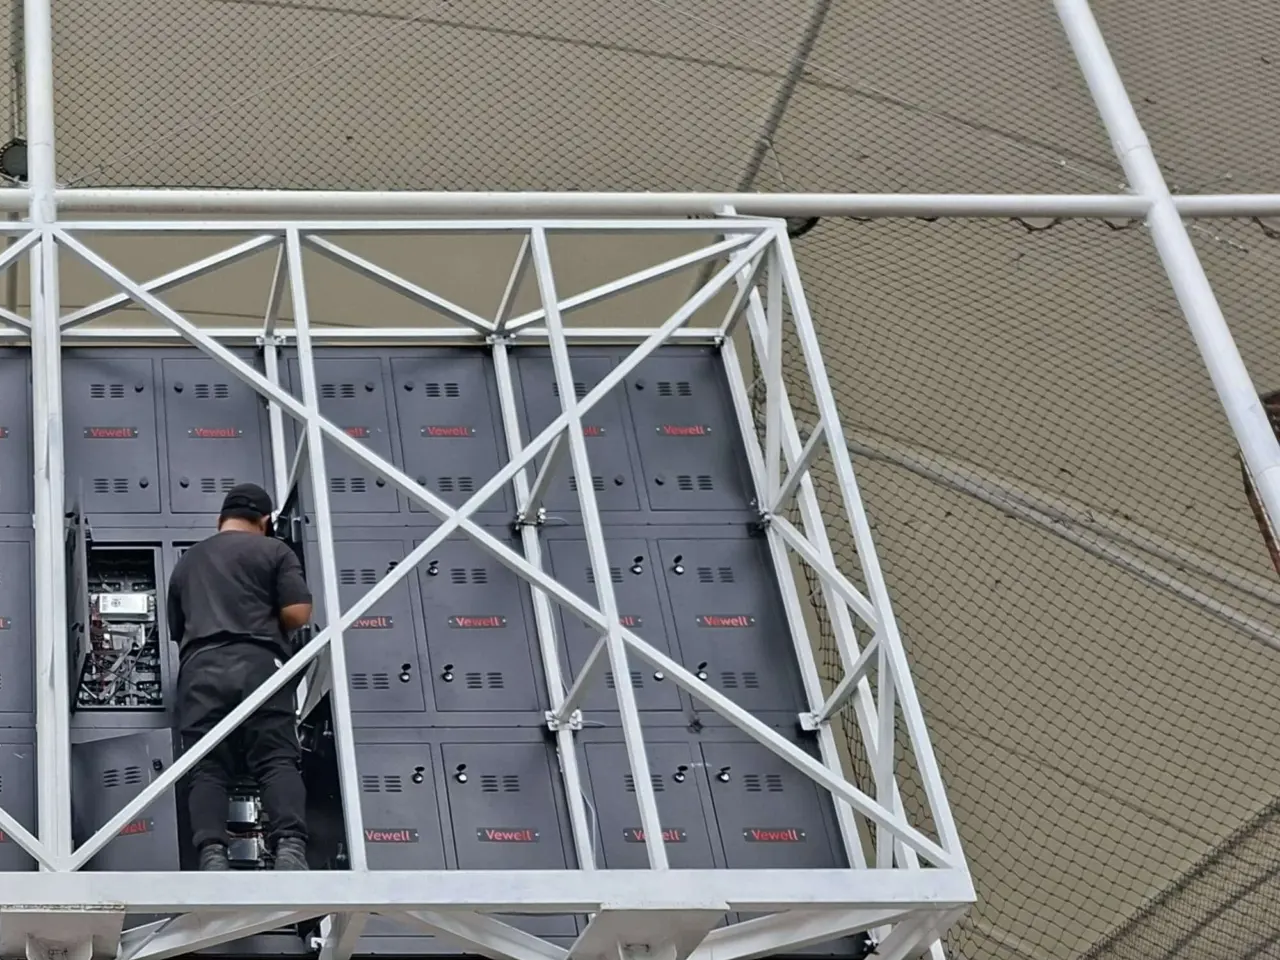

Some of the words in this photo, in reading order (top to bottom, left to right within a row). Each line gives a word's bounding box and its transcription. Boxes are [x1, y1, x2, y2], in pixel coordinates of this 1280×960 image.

[91, 427, 132, 437] Vewell
[195, 427, 236, 437] Vewell
[427, 426, 468, 436] Vewell
[663, 425, 704, 435] Vewell
[455, 617, 500, 627] Vewell
[703, 616, 748, 627] Vewell
[365, 829, 411, 841] Vewell
[485, 829, 533, 841] Vewell
[751, 829, 799, 841] Vewell
